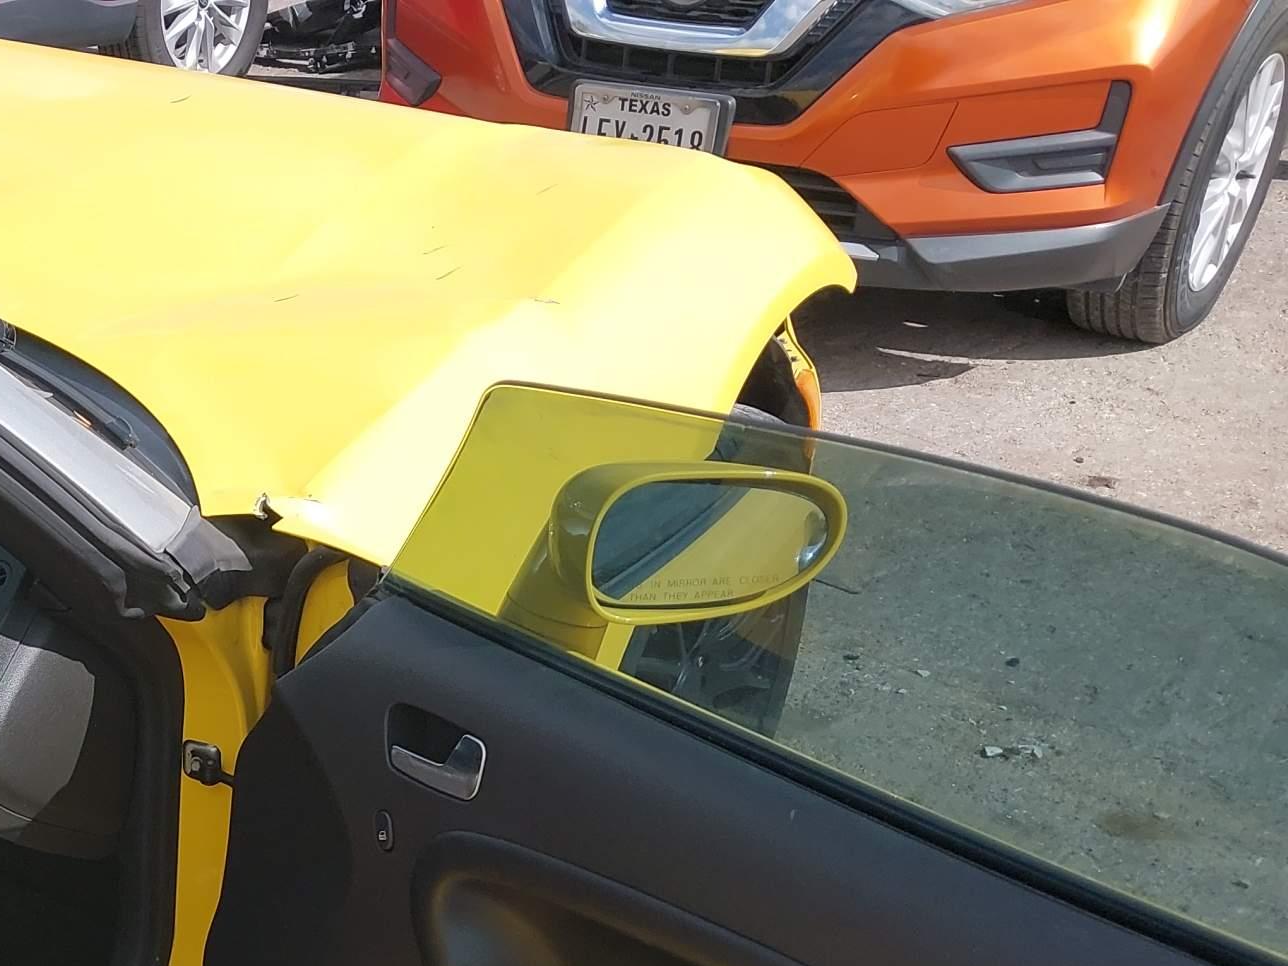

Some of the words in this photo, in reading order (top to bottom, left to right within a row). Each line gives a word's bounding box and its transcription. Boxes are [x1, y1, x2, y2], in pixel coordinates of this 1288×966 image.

[630, 91, 661, 100] NISSAN
[617, 97, 672, 117] TEXAS
[666, 578, 707, 588] MIRROR
[712, 576, 732, 586] ARE
[629, 592, 656, 601] THAN
[663, 591, 688, 600] THEY
[694, 589, 734, 600] APPEAR
